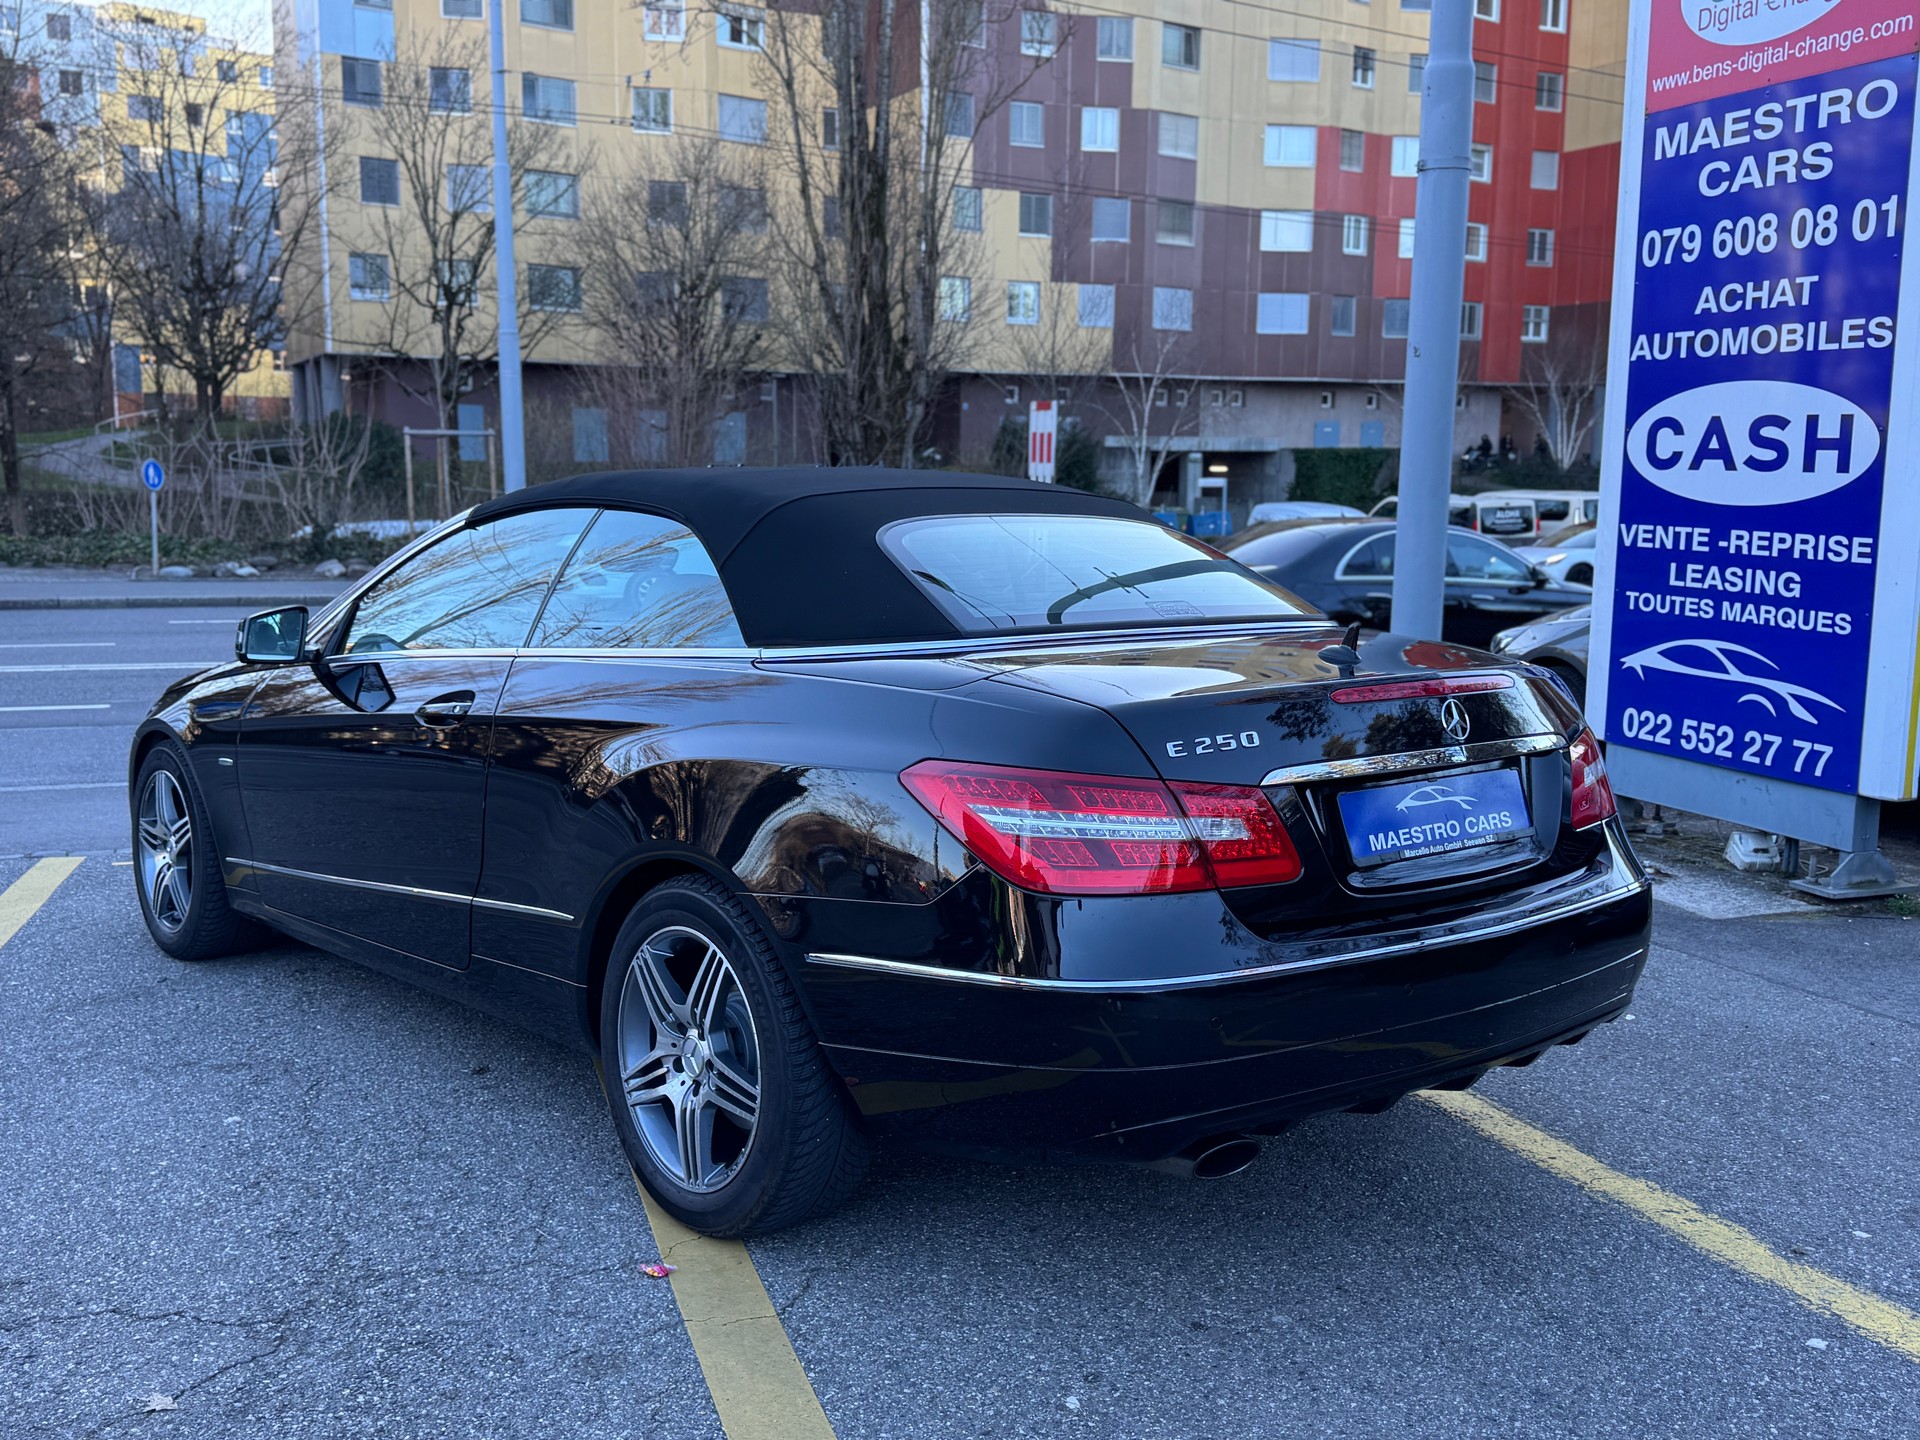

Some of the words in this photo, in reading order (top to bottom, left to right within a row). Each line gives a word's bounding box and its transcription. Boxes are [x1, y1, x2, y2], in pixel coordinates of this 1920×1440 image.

[1697, 0, 1759, 32] Digital
[1651, 14, 1914, 93] www.bens-digital-change.com
[1653, 78, 1898, 161] MAESTRO
[1698, 141, 1834, 197] CARS
[1642, 224, 1702, 267] 079
[1712, 213, 1778, 259] 608
[1790, 204, 1839, 249] 08
[1852, 194, 1899, 242] 01
[1694, 275, 1819, 315] ACHAT
[1630, 316, 1894, 362] AUTOMOBILES
[1645, 413, 1855, 474] CASH
[1619, 523, 1711, 552] VENTE
[1718, 529, 1873, 564] -REPRISE
[1669, 562, 1801, 598] LEASING
[1625, 591, 1714, 619] TOUTES
[1721, 601, 1852, 635] MARQUES
[1166, 740, 1188, 758] E
[1194, 730, 1260, 755] 250
[1622, 707, 1673, 745] 022
[1680, 719, 1734, 758] 552
[1742, 730, 1783, 766] 27
[1792, 739, 1834, 777] 77
[1368, 820, 1460, 851] MAESTRO
[1465, 811, 1512, 834] CARS
[1430, 844, 1444, 853] Auto
